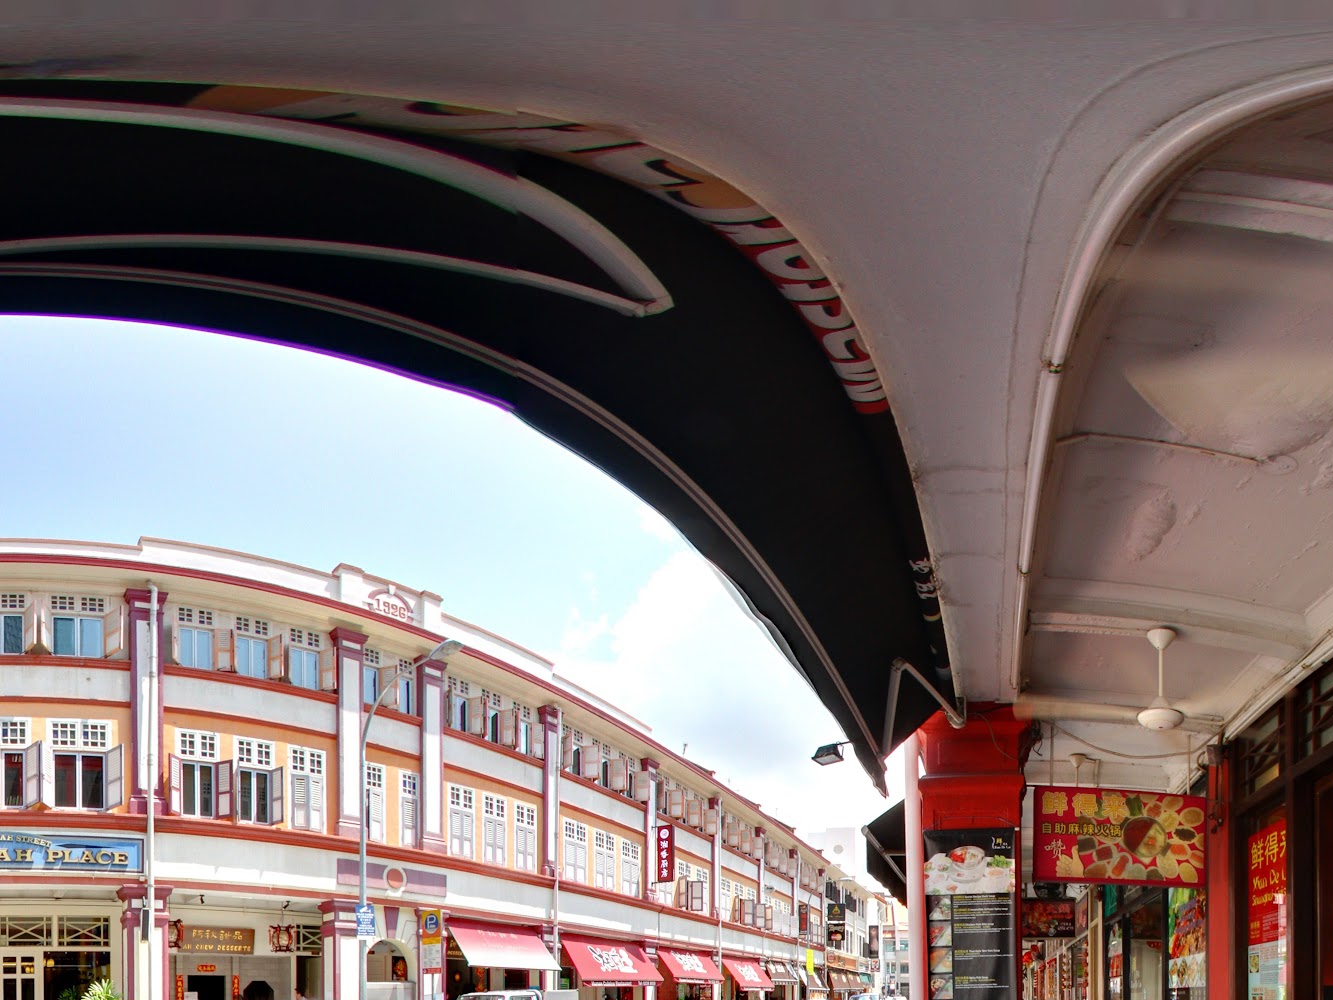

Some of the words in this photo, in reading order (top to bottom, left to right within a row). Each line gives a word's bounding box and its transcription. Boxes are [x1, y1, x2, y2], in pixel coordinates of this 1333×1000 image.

[374, 598, 406, 619] 1926
[1041, 791, 1127, 818] 鲜得来
[1042, 823, 1122, 837] 自助麻辣火锅
[16, 836, 53, 848] STREET
[45, 849, 129, 865] PLACE
